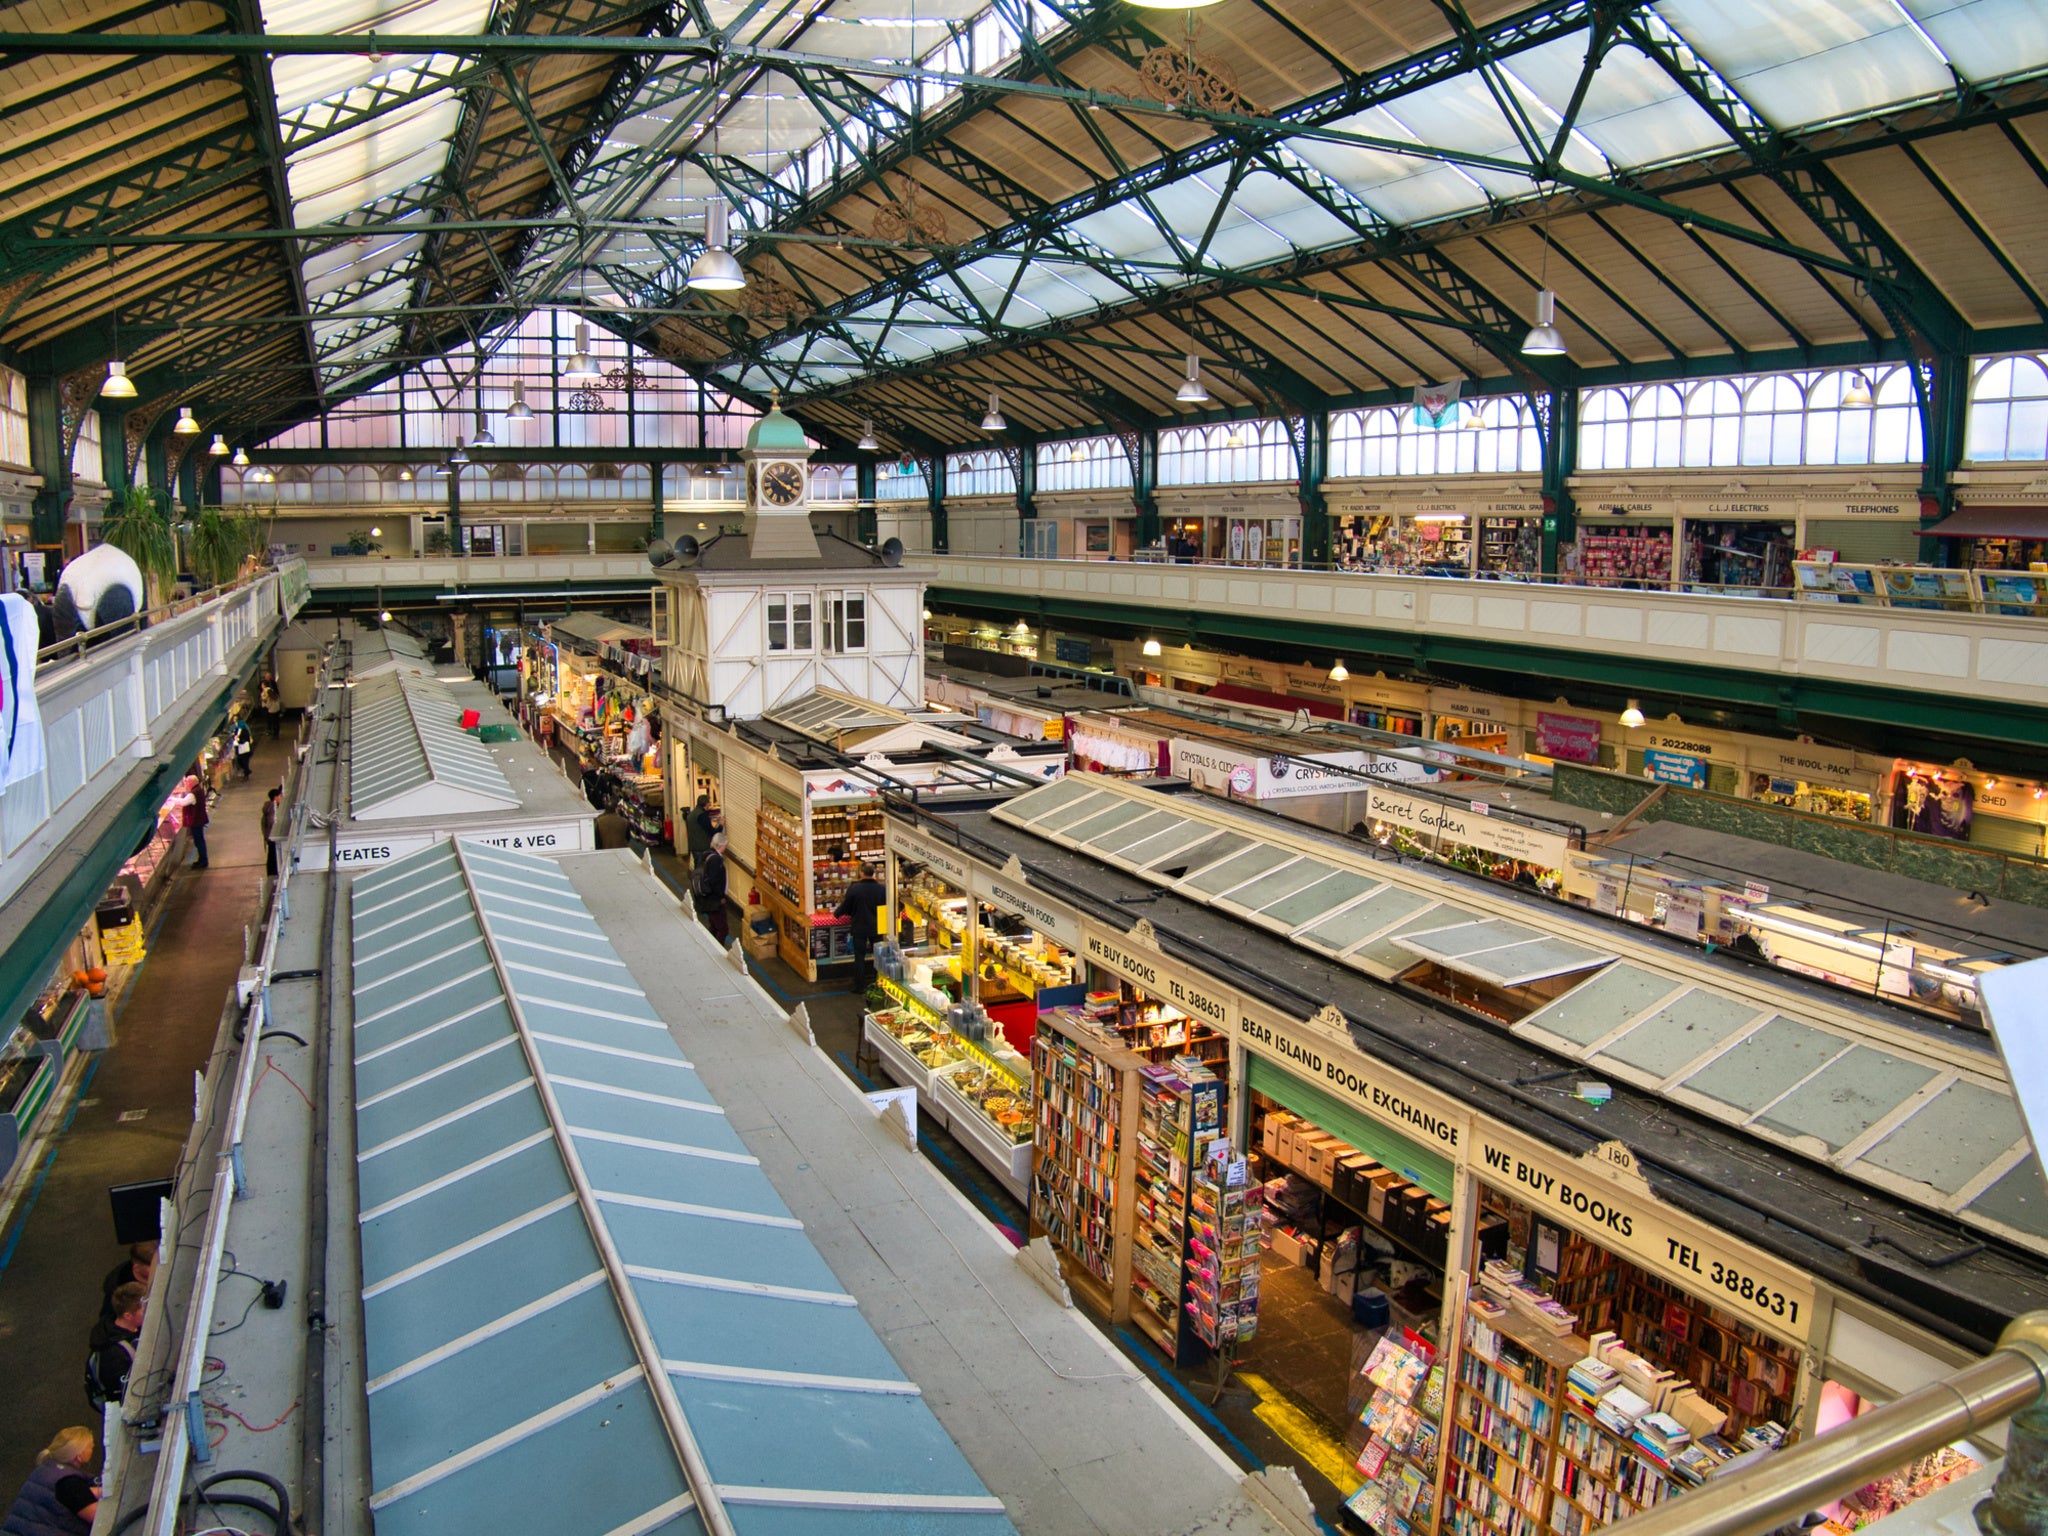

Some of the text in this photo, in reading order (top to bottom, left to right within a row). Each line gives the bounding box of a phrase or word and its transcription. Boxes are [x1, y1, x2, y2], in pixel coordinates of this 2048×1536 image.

[1731, 504, 1769, 512] ELECTRICS
[1846, 505, 1900, 514] TELEPHONES
[1451, 703, 1490, 716] HARD LINES
[1662, 738, 1712, 754] 20228088
[1180, 750, 1210, 769] CRYSTALS
[1210, 758, 1217, 770] &
[1779, 755, 1795, 766] THE
[1358, 762, 1398, 775] CLOCKS
[1319, 783, 1337, 791] WATCH
[1338, 781, 1362, 790] BATTERIES
[1981, 793, 2007, 807] SHED
[1372, 796, 1466, 836] Secret Garden
[513, 836, 523, 848] &
[527, 834, 556, 847] VEG
[333, 846, 391, 861] YEATES
[991, 885, 1056, 928] MEDITERRANEAN FOODS
[1088, 936, 1225, 1022] WE BUY BOOKS TEL 388631
[1326, 1010, 1341, 1026] 178
[1242, 1016, 1458, 1147] BEAR ISLAND BOOK EXCHANGE
[1608, 1146, 1630, 1168] 180
[1484, 1144, 1799, 1324] WE BUY BOOKS TEL 388631
